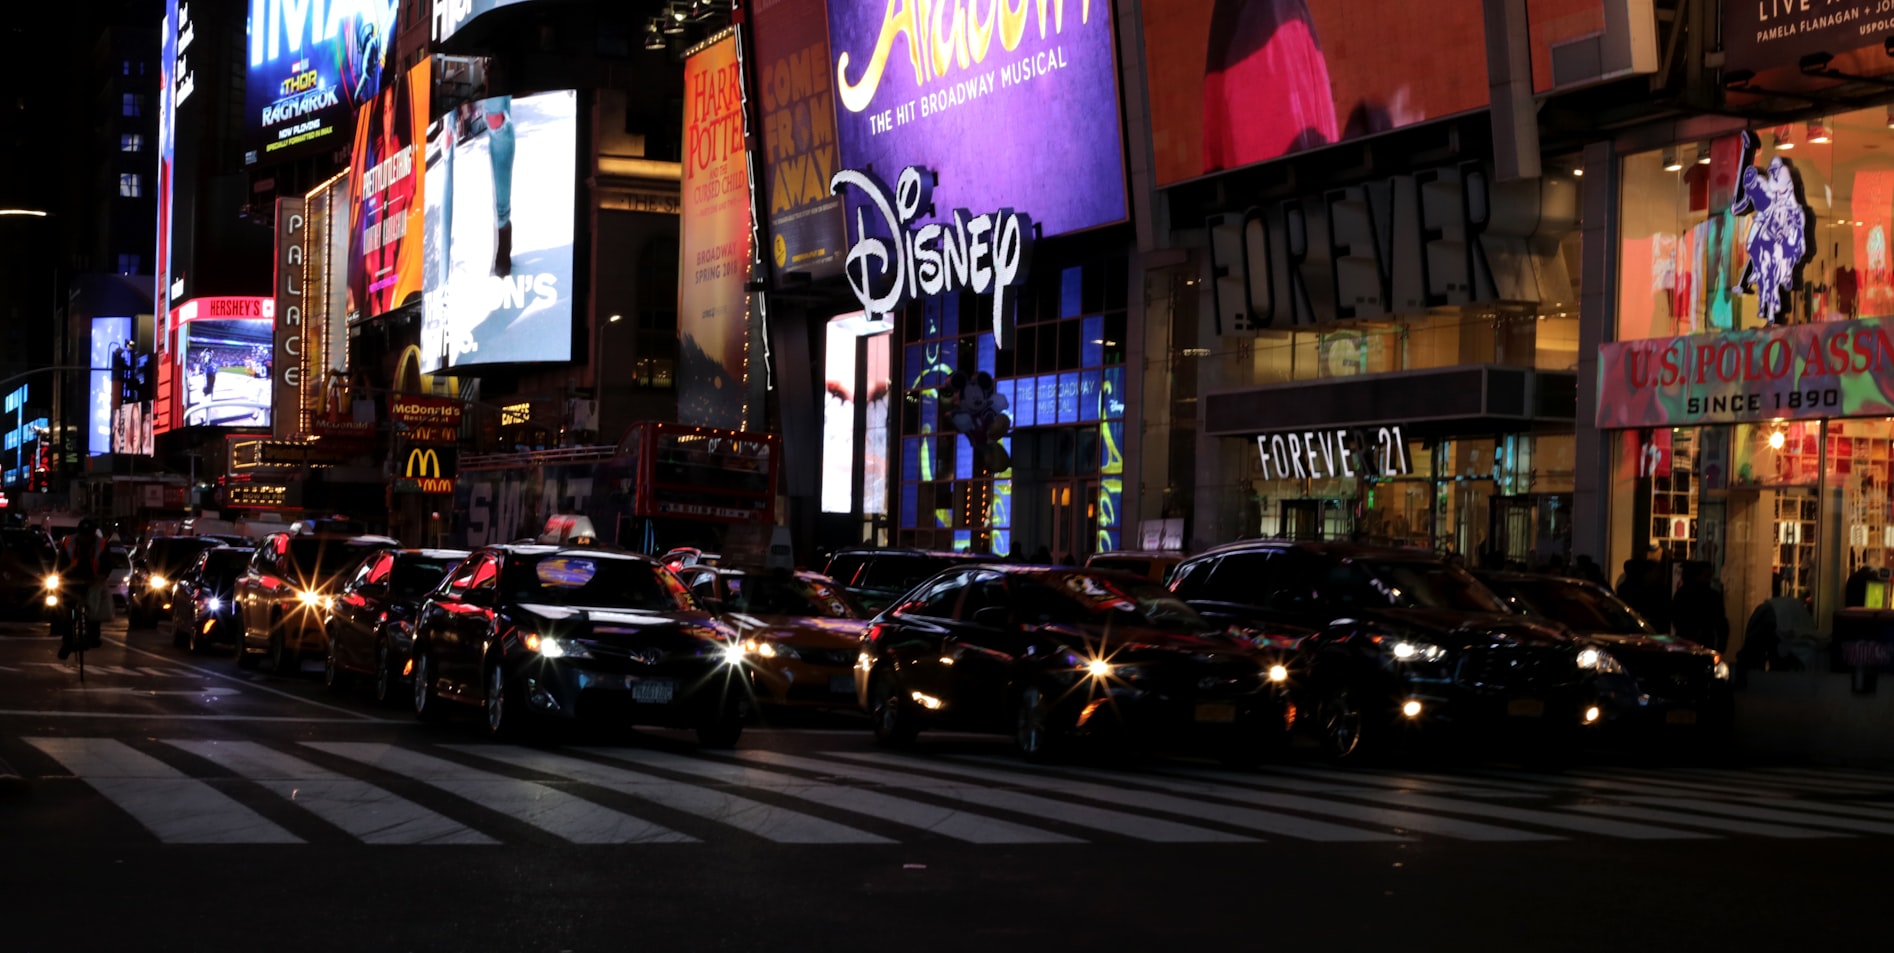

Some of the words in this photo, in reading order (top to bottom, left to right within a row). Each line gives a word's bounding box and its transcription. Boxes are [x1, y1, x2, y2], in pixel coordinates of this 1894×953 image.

[1756, 23, 1796, 43] PAMELA
[1800, 7, 1859, 33] FLANAGAN
[284, 70, 317, 95] THOR
[693, 62, 741, 123] HARR
[762, 41, 828, 112] COME
[870, 109, 893, 136] THE
[896, 100, 916, 127] HIT
[921, 71, 995, 118] BROADWAY
[1001, 46, 1067, 89] MUSICAL
[262, 85, 338, 127] RAGNAROK
[763, 92, 833, 164] FROM
[694, 180, 720, 204] CURSED
[722, 170, 745, 194] CHILD
[770, 144, 834, 215] AWAY
[697, 242, 737, 266] BROADWAY
[1209, 159, 1499, 335] FOREVER
[695, 265, 720, 284] SPRING
[210, 300, 260, 316] HERSHEY'S
[284, 214, 304, 386] PALACE
[1630, 349, 1686, 388] U.S.
[1696, 338, 1791, 384] POLO
[393, 403, 461, 416] McDonald's
[1687, 394, 1760, 414] SINCE
[1774, 389, 1838, 409] 1890
[1378, 426, 1407, 476] 21
